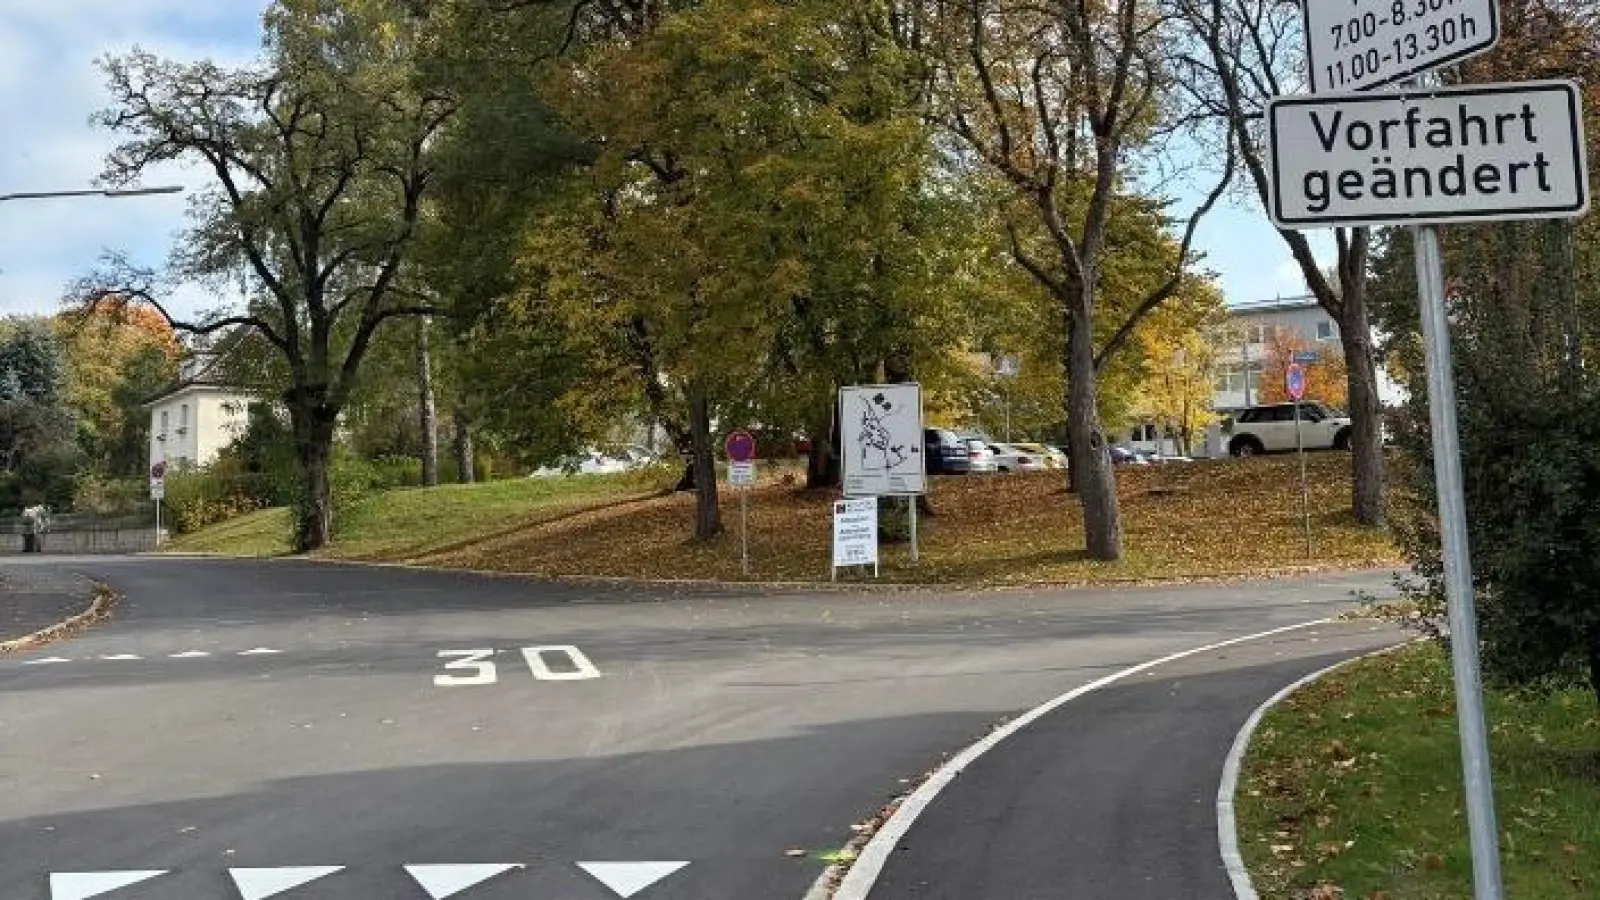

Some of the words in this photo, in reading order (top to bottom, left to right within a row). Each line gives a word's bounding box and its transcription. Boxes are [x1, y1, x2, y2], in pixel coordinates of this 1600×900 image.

[1331, 0, 1463, 50] 7.00-8.3
[1309, 104, 1537, 152] Vorfahrt
[1303, 153, 1551, 213] geändert
[434, 645, 601, 686] 30
